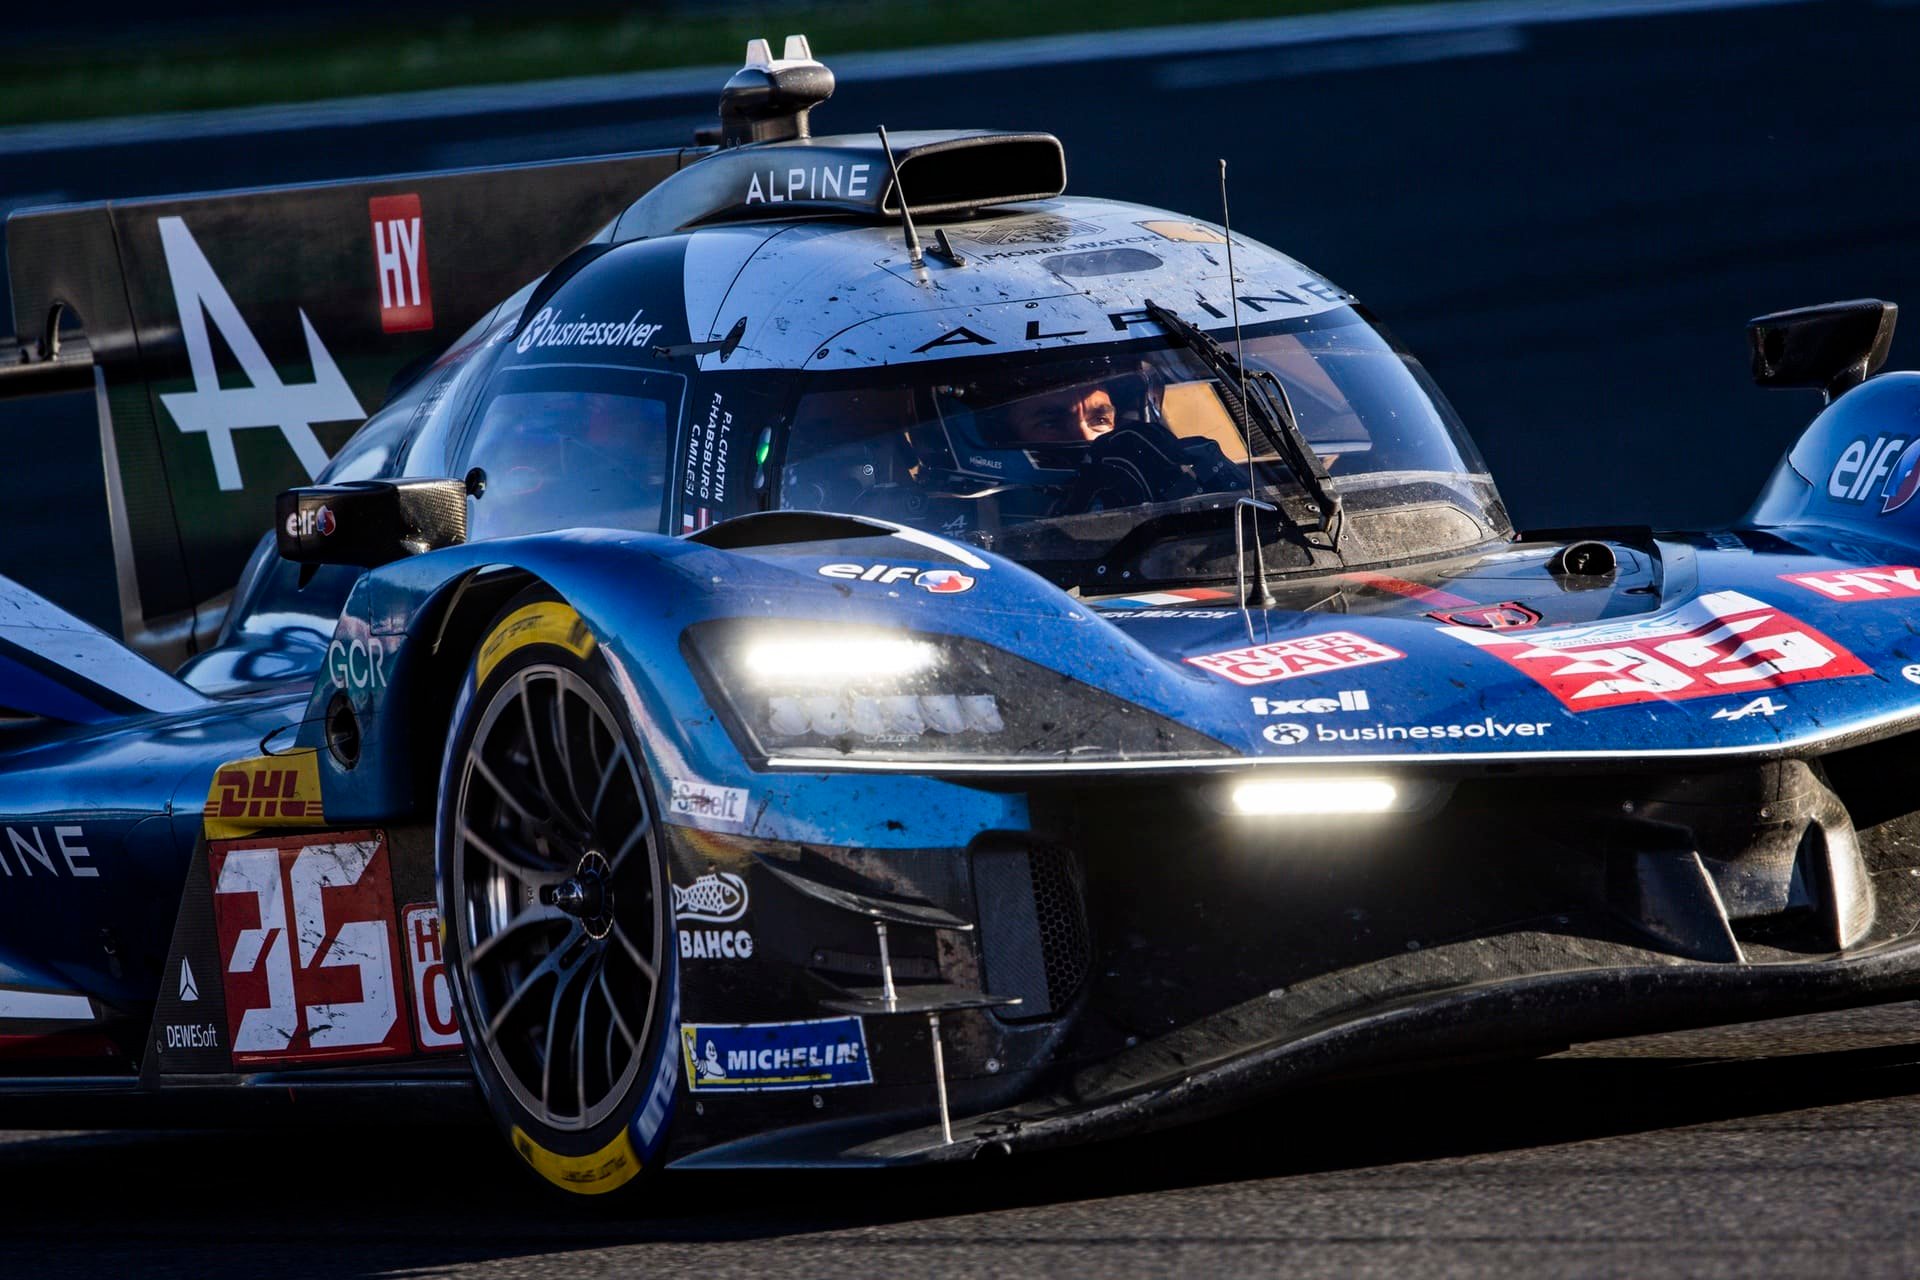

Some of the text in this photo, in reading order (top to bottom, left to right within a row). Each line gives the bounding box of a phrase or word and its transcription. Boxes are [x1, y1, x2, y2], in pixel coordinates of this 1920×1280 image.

[745, 164, 870, 205] ALPINE
[374, 217, 421, 308] HY
[536, 308, 663, 348] businessolver
[684, 424, 701, 496] C.MILESI
[700, 391, 723, 500] F.HABSBURG
[714, 411, 733, 503] P.L.CHATIN
[1828, 437, 1905, 501] elf
[285, 511, 316, 537] elf
[818, 563, 918, 584] elf
[328, 638, 387, 689] GCR
[1198, 634, 1353, 666] HYPER
[1225, 643, 1382, 681] CAR
[1512, 614, 1838, 700] 35
[1250, 690, 1370, 716] ixell
[1316, 717, 1552, 742] businessolver
[216, 770, 307, 818] DHL
[215, 841, 398, 1052] 35
[679, 930, 753, 960] BAHCO
[165, 1023, 219, 1049] DEWESoft
[727, 1042, 860, 1071] MICHELIN
